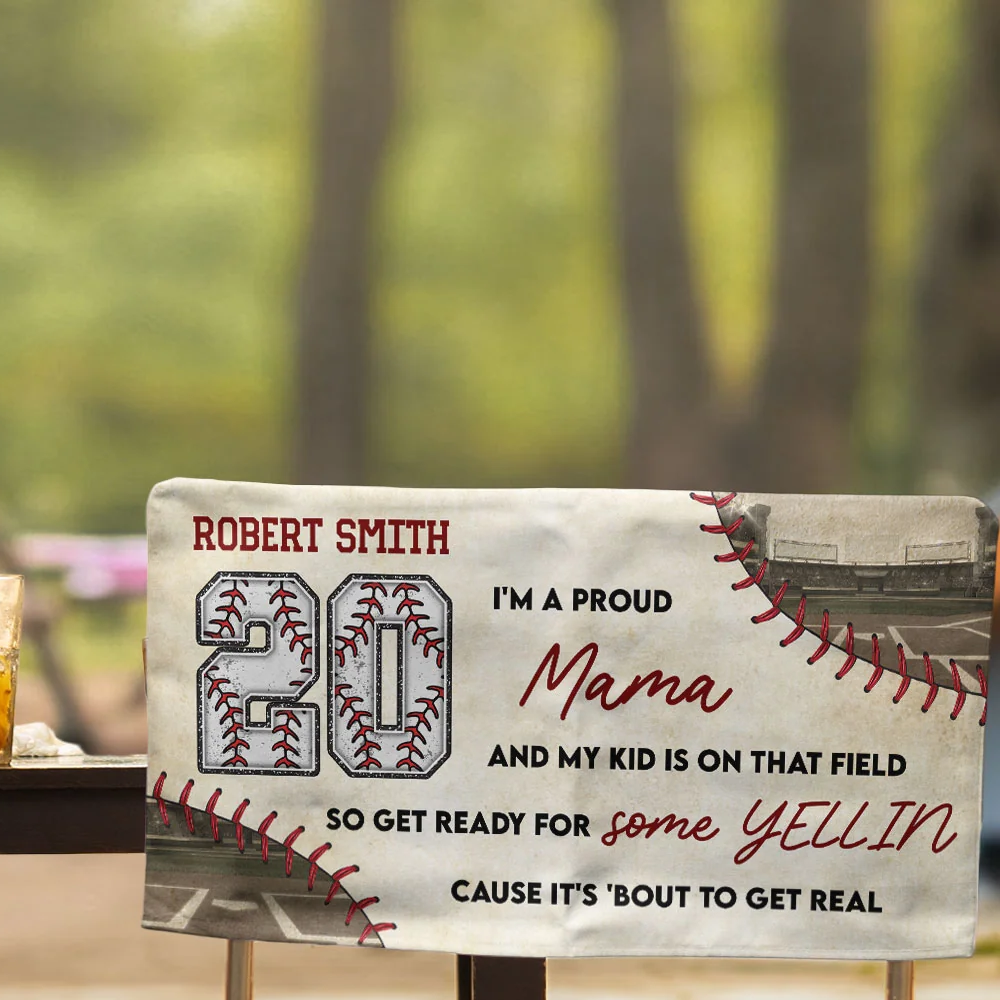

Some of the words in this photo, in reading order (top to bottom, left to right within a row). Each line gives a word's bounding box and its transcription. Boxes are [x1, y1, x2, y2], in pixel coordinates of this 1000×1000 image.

[192, 515, 324, 553] ROBERT
[335, 518, 450, 555] SMITH
[493, 586, 533, 611] I'M
[541, 587, 564, 611] A
[572, 587, 673, 614] PROUD
[194, 570, 454, 780] 20
[518, 641, 734, 721] Mama
[486, 743, 550, 769] AND
[558, 745, 601, 770] MY
[609, 746, 656, 771] KID
[664, 748, 689, 772] IS
[697, 748, 742, 774] ON
[750, 750, 823, 775] THAT
[830, 752, 907, 777] FIELD
[325, 807, 365, 832] SO
[372, 808, 428, 833] GET
[435, 810, 527, 836] READY
[534, 812, 591, 838] FOR
[600, 810, 721, 847] some
[733, 798, 958, 866] YELLIN
[450, 879, 542, 905] CAUSE
[550, 882, 598, 907] IT'S
[606, 883, 691, 909] 'BOUT
[698, 885, 738, 910] TO
[745, 886, 802, 911] GET
[810, 888, 883, 914] REAL
